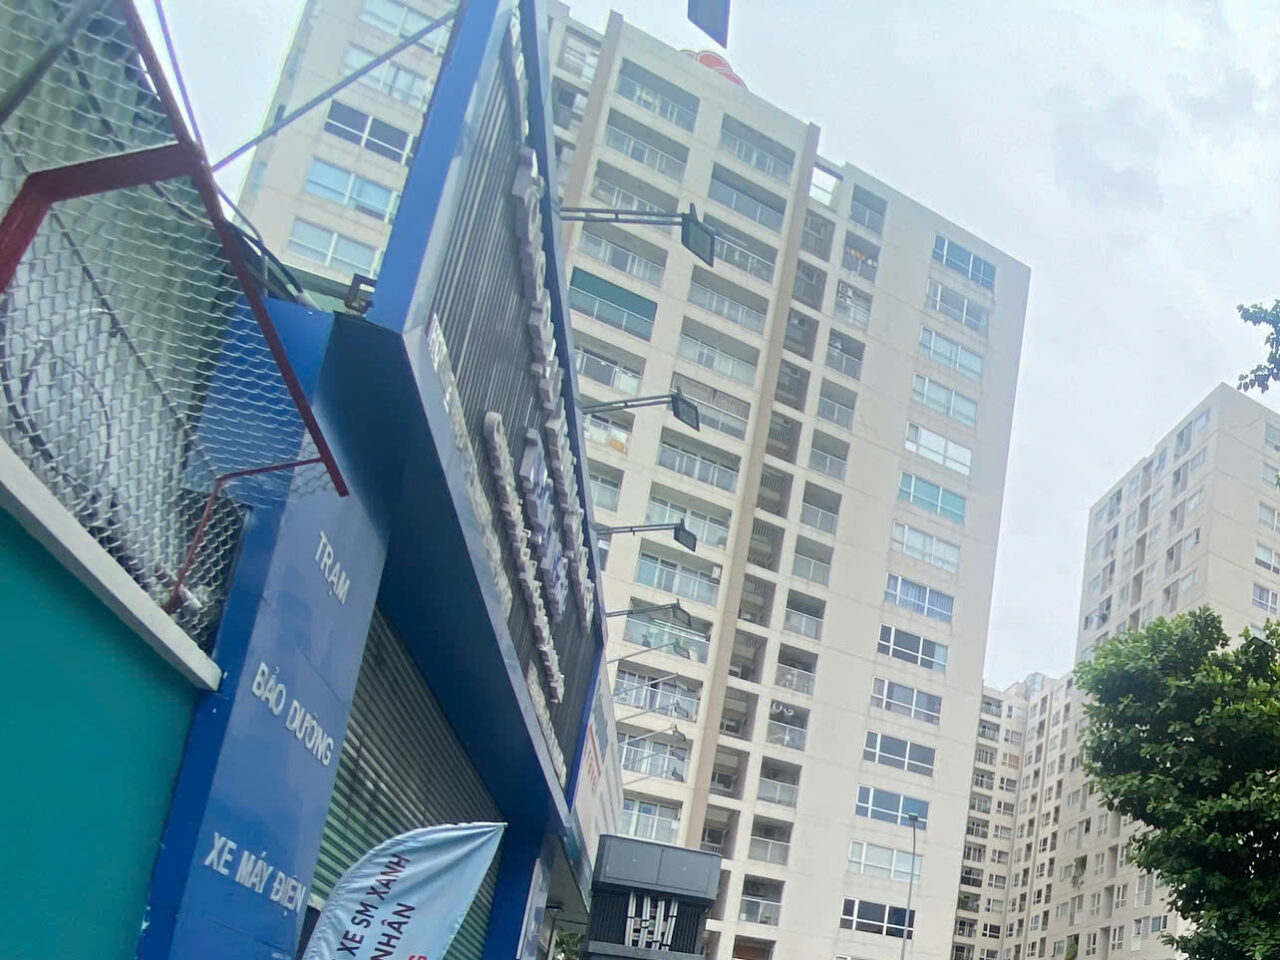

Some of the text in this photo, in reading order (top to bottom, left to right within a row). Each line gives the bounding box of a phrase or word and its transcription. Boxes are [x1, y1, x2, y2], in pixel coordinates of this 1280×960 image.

[314, 531, 350, 605] TRẠM
[252, 661, 288, 716] BẢO
[204, 832, 306, 917] XE MÁY ĐIỆN
[337, 930, 365, 959] XE
[351, 901, 379, 929] SM
[366, 854, 412, 901] XANH
